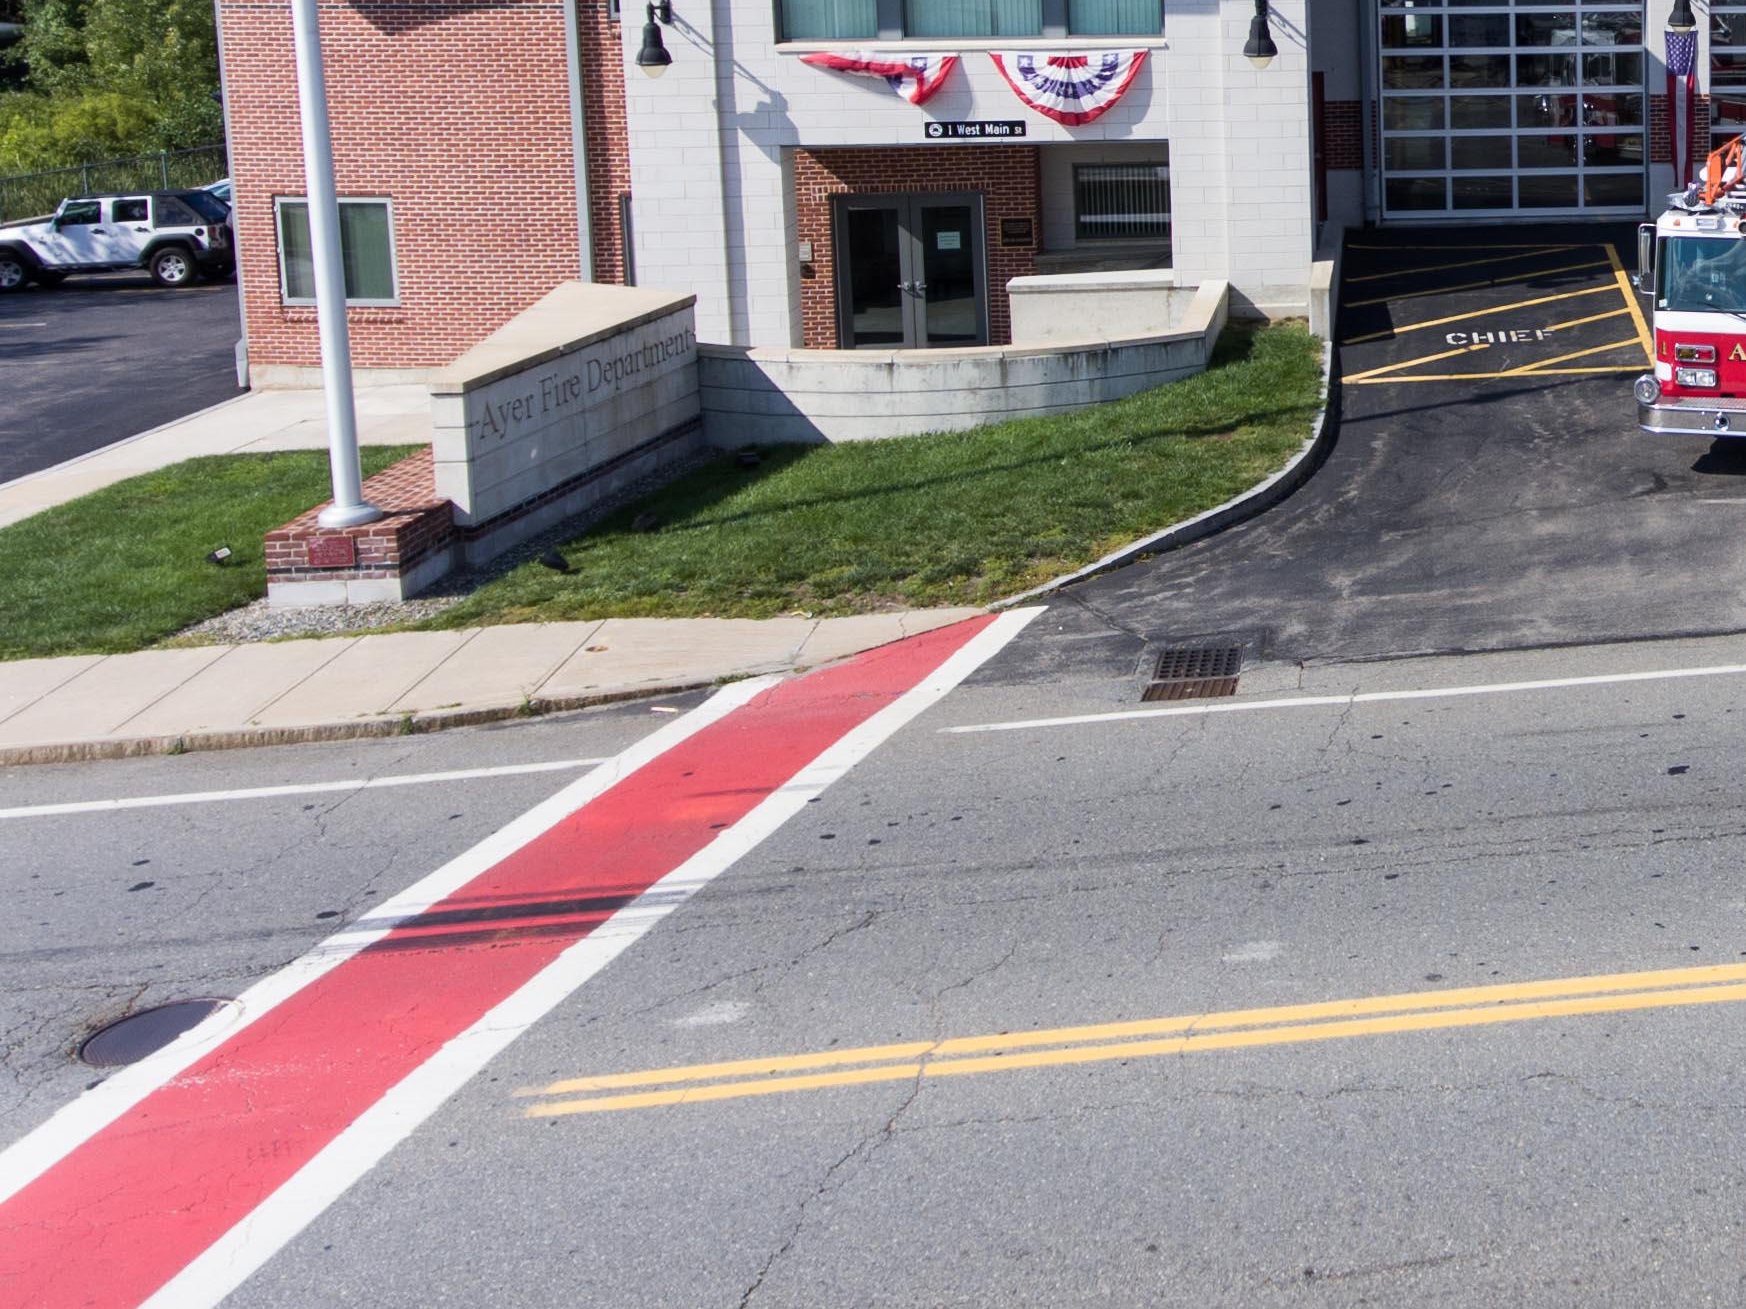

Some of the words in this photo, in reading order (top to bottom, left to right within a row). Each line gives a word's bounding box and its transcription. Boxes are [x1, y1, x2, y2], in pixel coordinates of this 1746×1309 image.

[948, 125, 952, 136] 1
[957, 124, 980, 135] West
[985, 124, 1010, 135] Main
[1445, 330, 1556, 345] CHIEF
[480, 393, 534, 438] Ayer
[538, 374, 580, 414] Fire
[587, 327, 692, 393] Department
